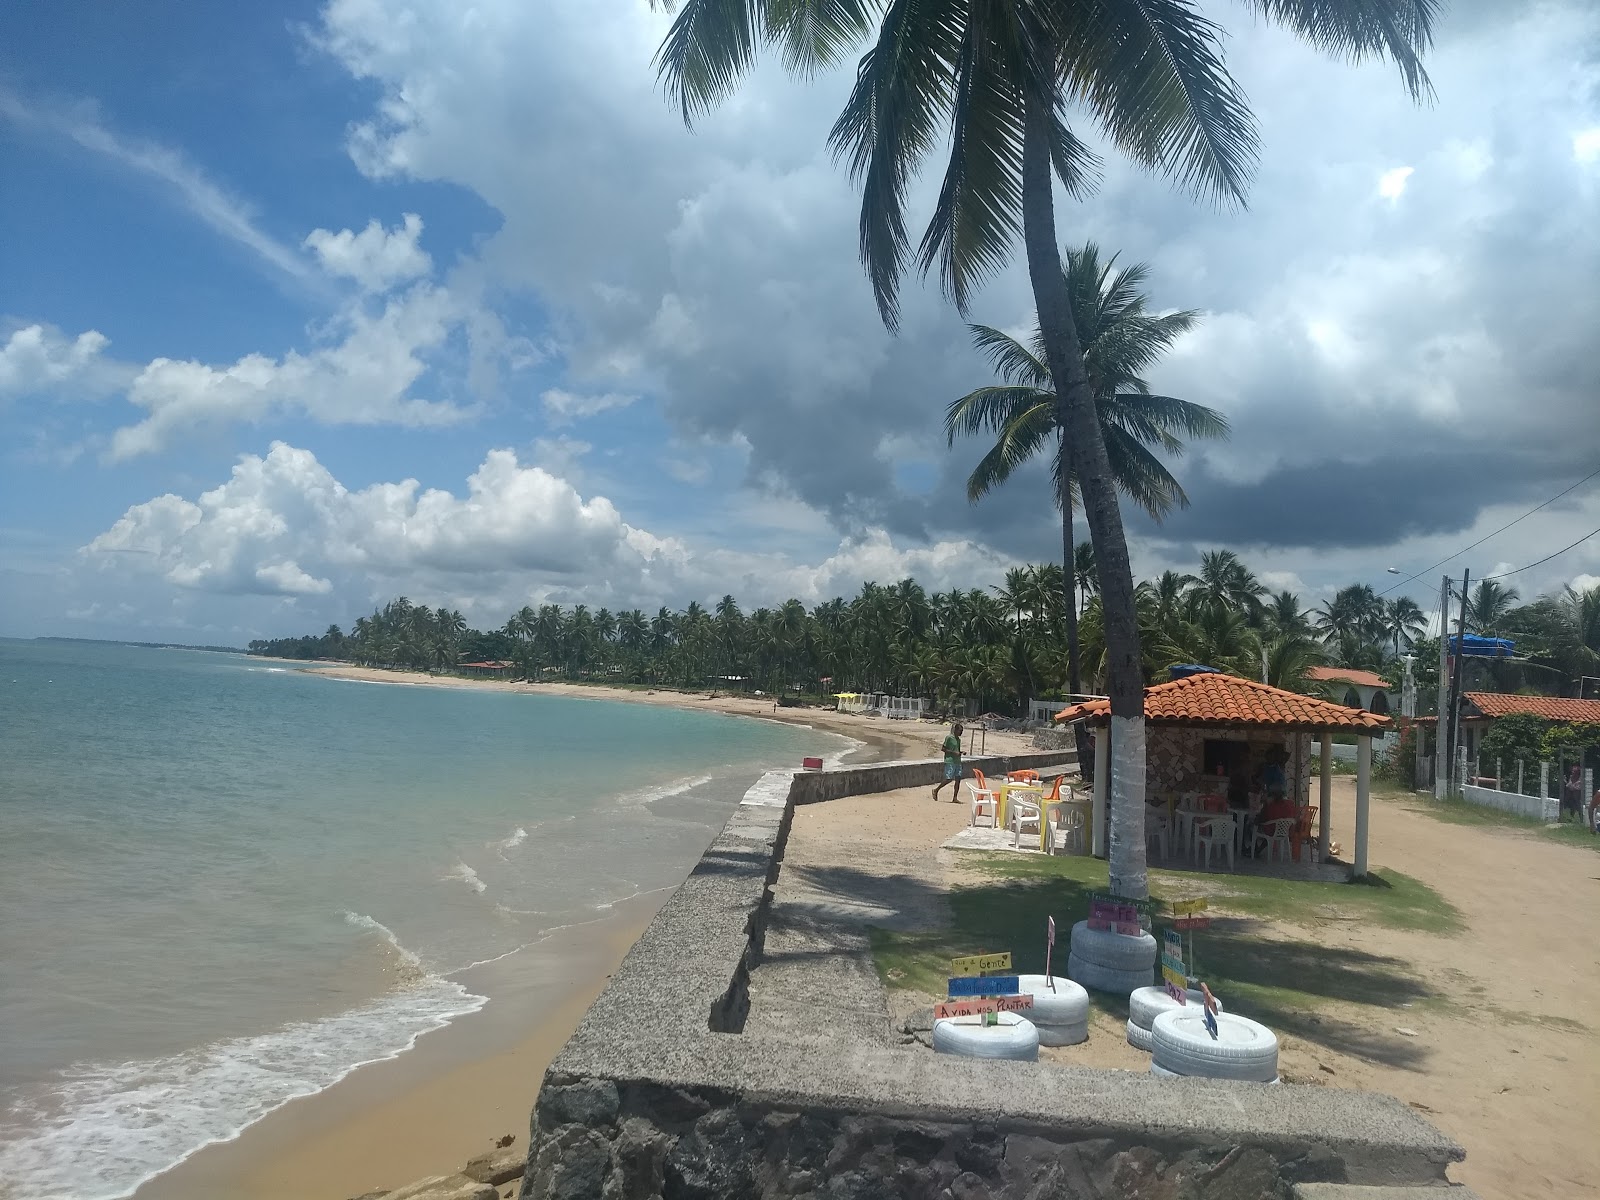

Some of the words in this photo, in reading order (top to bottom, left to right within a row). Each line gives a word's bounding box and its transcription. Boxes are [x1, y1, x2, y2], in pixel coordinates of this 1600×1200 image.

[979, 958, 1006, 969] Gente
[1168, 982, 1183, 1002] PAZ
[940, 1006, 949, 1018] A
[951, 1009, 971, 1017] VIDA
[977, 1006, 993, 1014] NOS
[996, 998, 1031, 1012] PLANTAR
